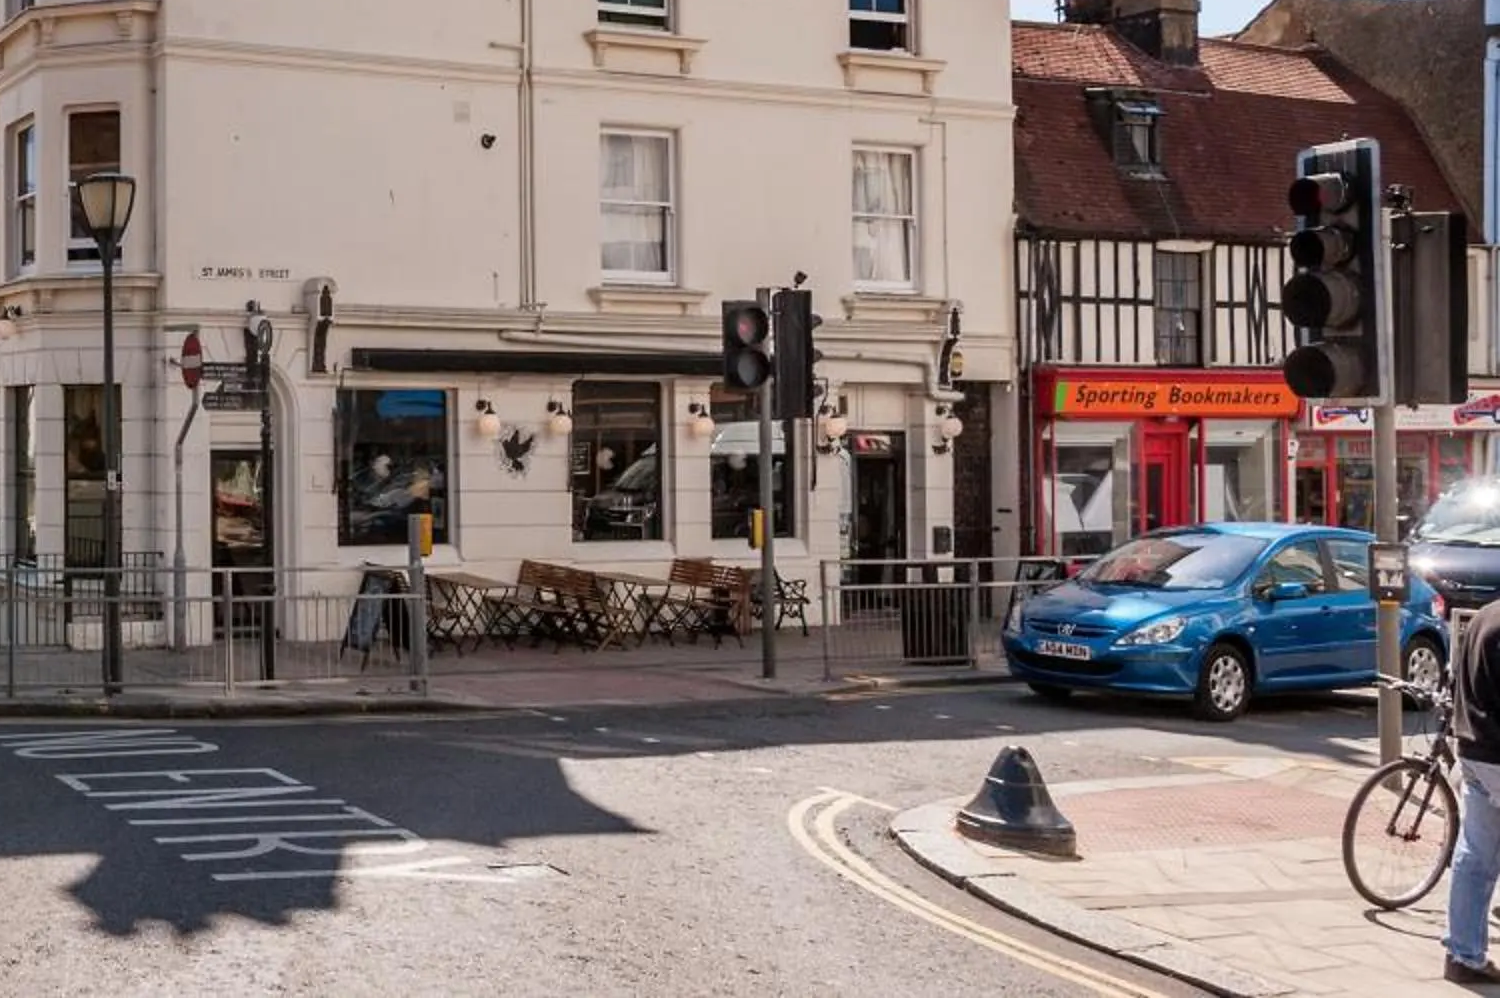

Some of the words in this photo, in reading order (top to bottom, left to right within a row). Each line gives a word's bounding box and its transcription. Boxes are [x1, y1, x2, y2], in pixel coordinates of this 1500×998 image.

[201, 267, 213, 277] ST
[1075, 384, 1157, 409] Sporting
[1168, 386, 1281, 405] Bookmakers
[53, 767, 517, 882] ENTRY
